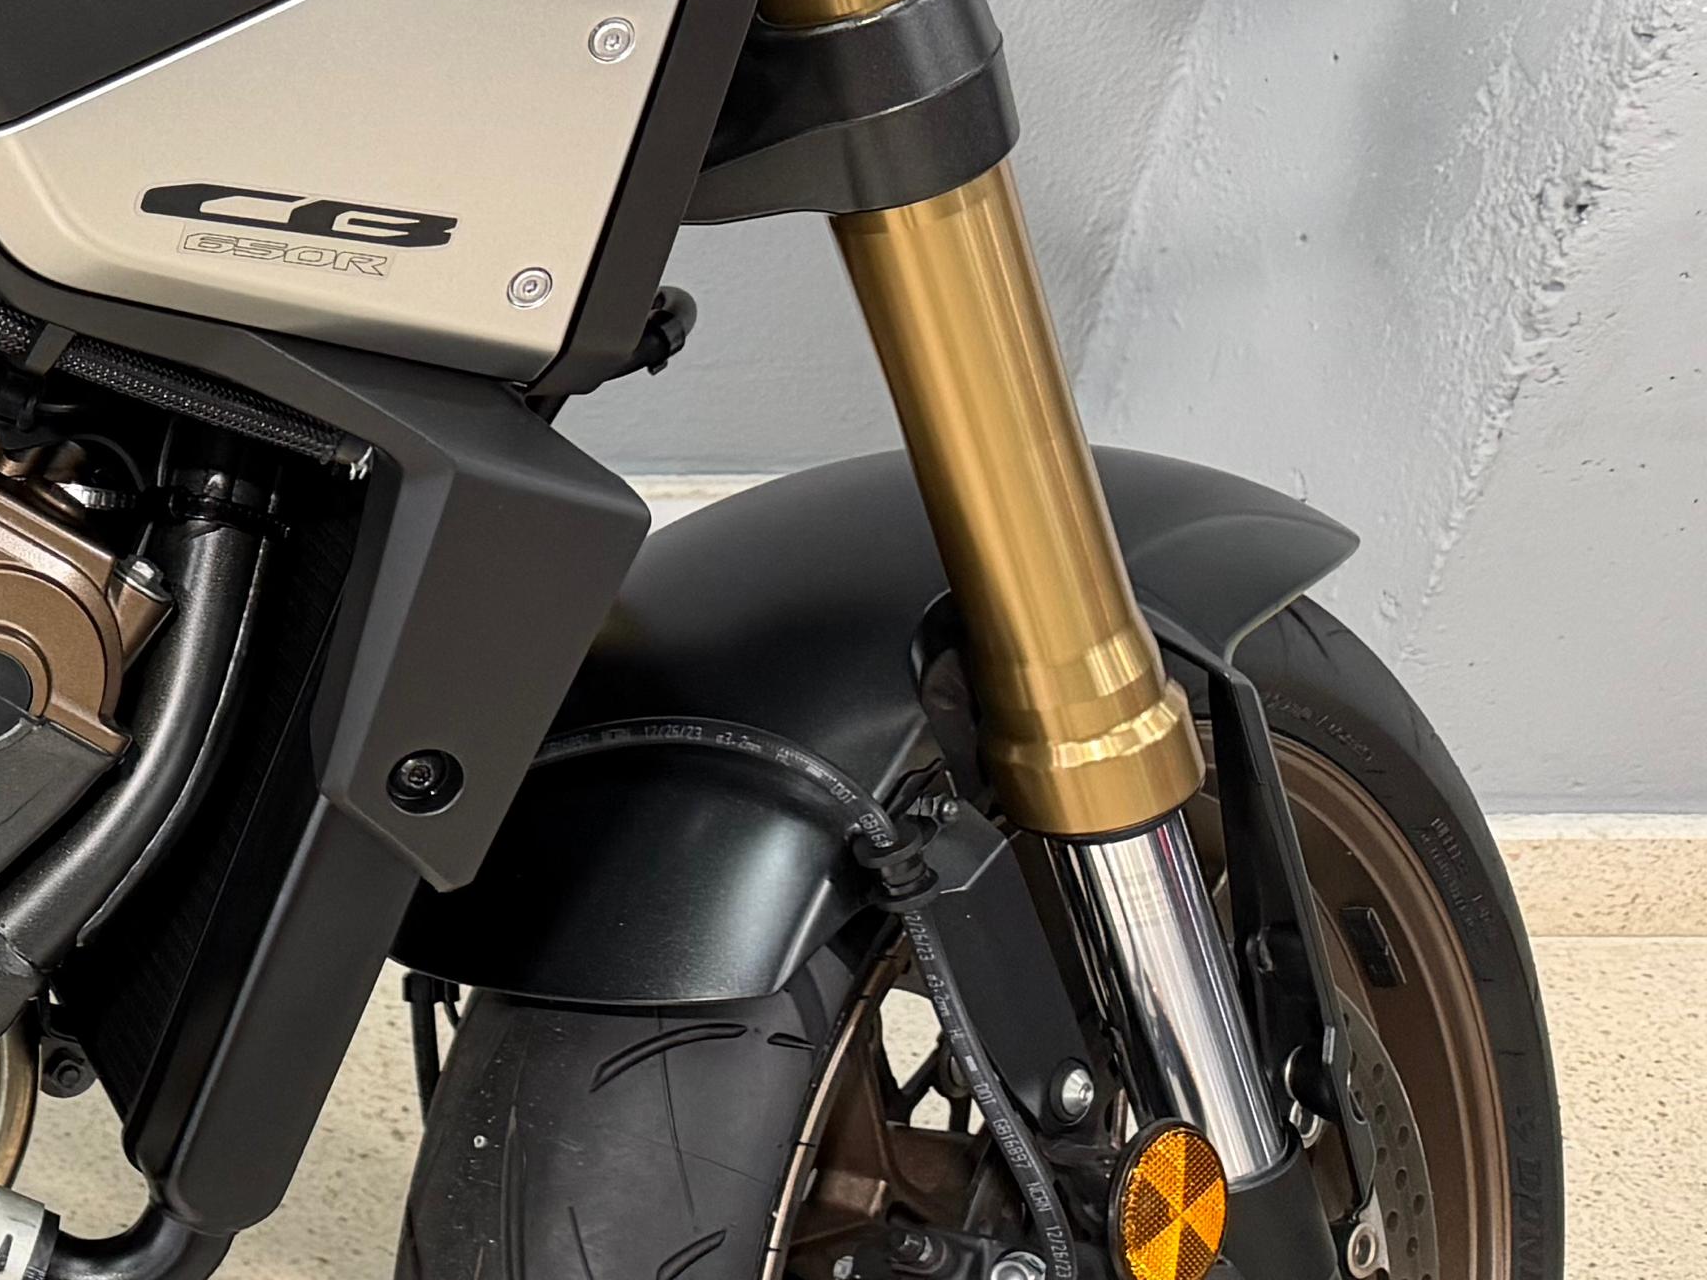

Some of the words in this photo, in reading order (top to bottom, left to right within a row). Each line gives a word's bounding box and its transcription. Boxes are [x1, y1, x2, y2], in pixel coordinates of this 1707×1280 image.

[141, 183, 457, 247] CB
[184, 232, 387, 276] 650R
[973, 1083, 998, 1106] DOT
[1046, 1225, 1073, 1278] 12/26/23
